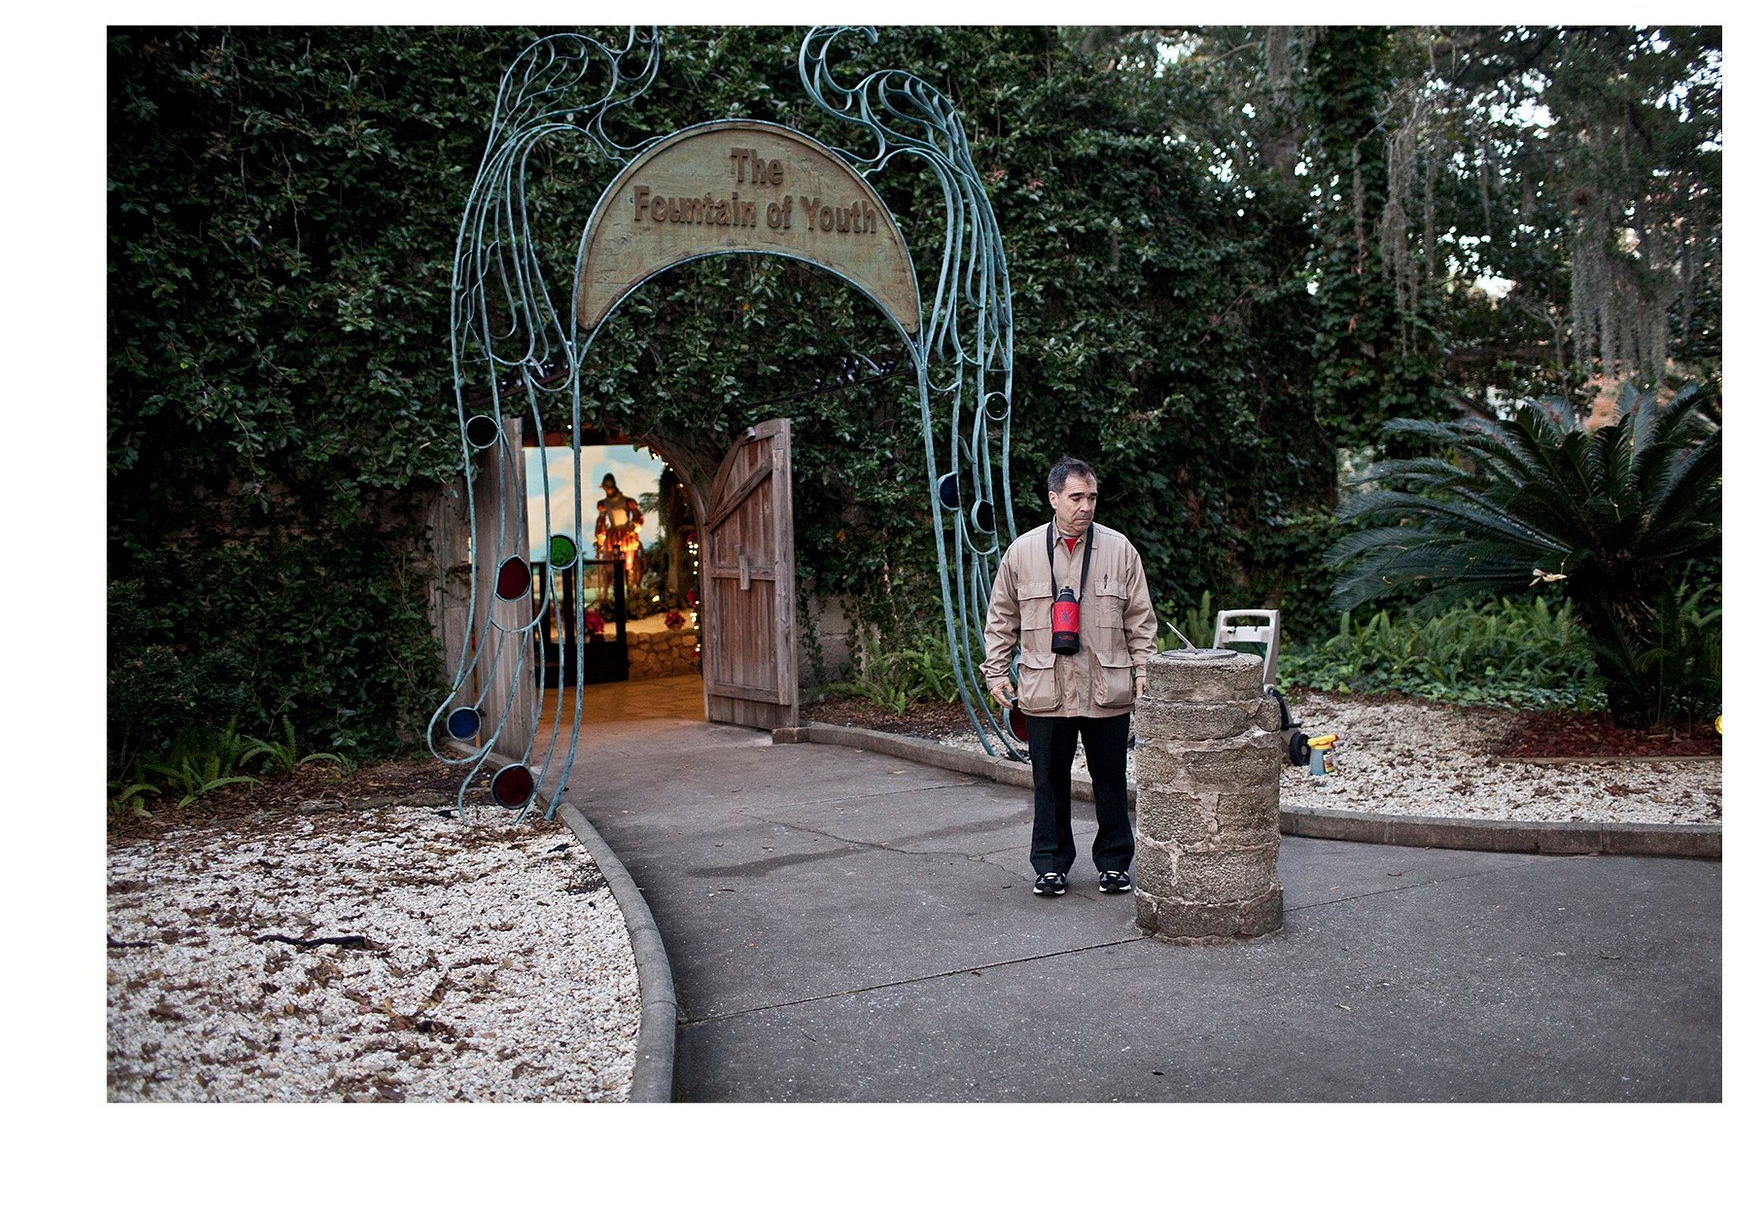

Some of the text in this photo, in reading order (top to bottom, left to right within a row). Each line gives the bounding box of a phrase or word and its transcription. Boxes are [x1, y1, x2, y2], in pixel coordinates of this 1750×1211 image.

[730, 147, 784, 185] The
[633, 185, 877, 234] Fountain of Youth
